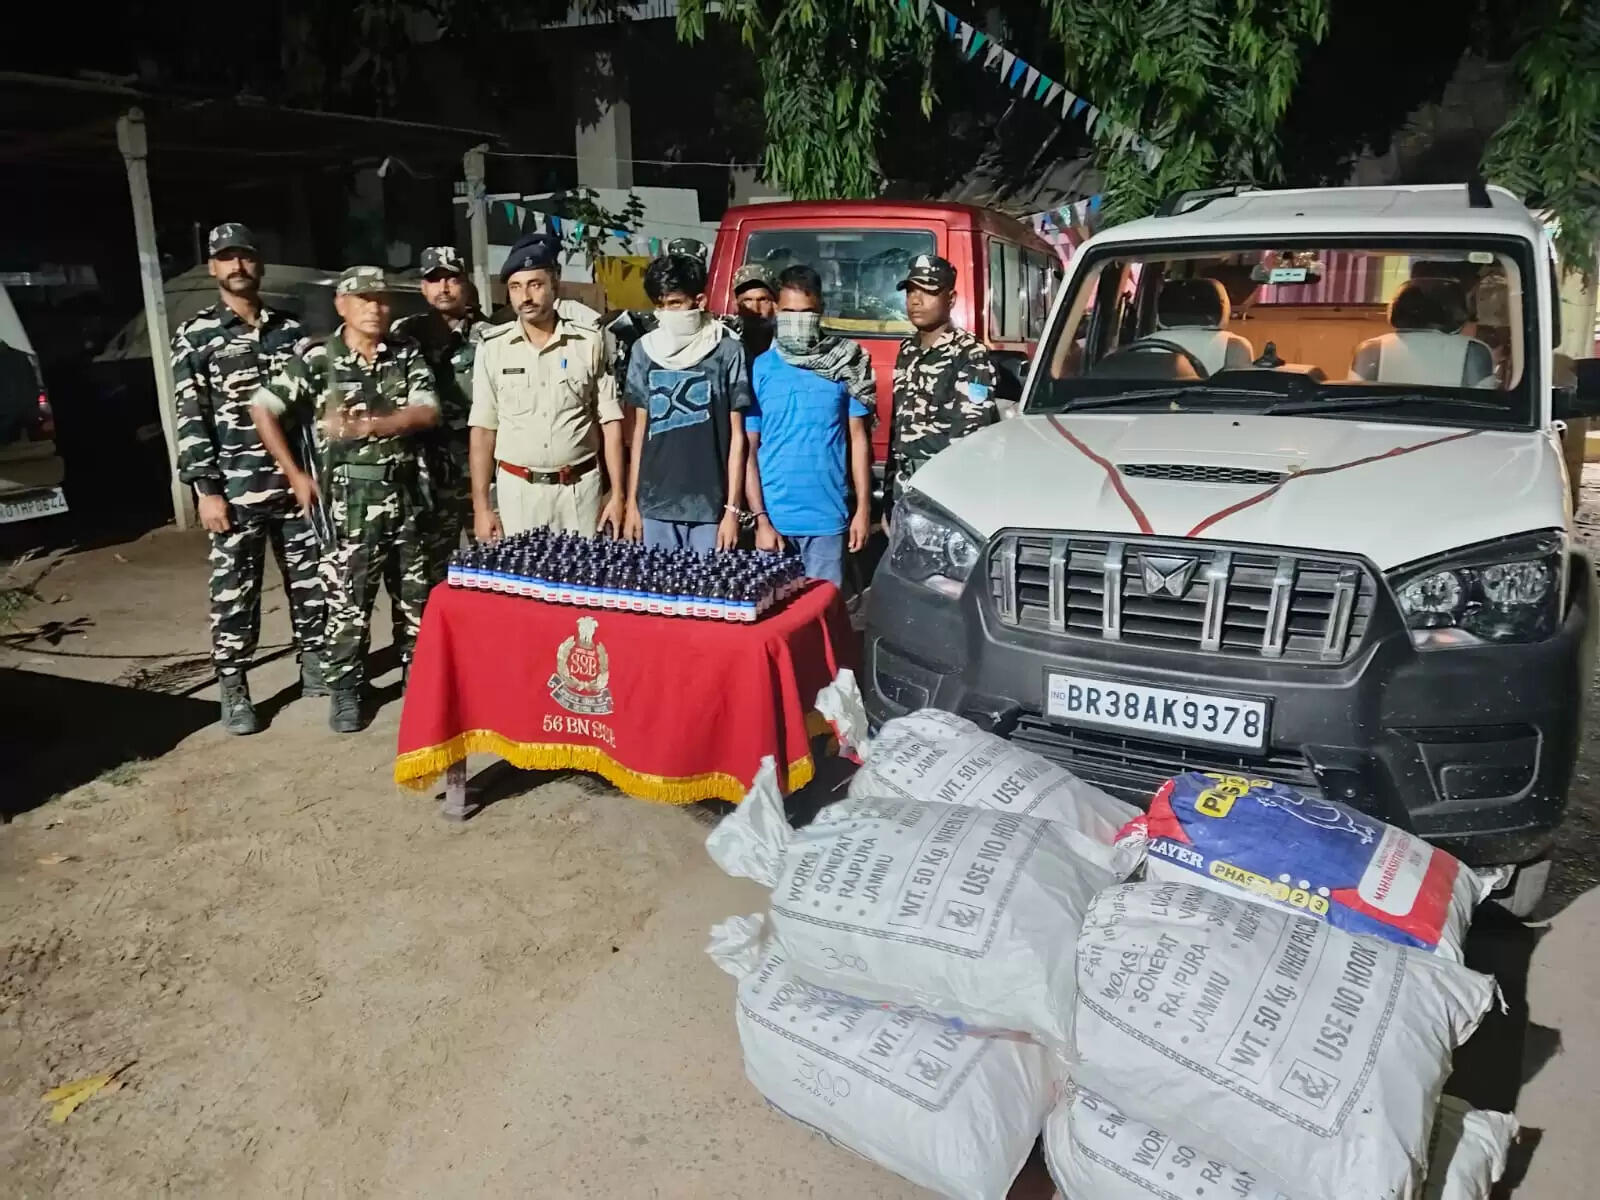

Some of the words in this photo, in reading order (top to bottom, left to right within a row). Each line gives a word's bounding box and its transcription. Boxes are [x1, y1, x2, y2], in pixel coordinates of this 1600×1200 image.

[570, 653, 597, 676] SSB
[543, 714, 563, 732] 56
[566, 716, 590, 736] BN
[1067, 684, 1260, 738] BR38AK9378
[936, 776, 966, 801] WT.
[959, 763, 977, 781] 50
[992, 774, 1026, 805] USE
[937, 822, 961, 851] WHEN
[814, 834, 853, 894] SONEPAT
[838, 837, 879, 898] RAJPURA
[862, 854, 894, 903] JAMMU
[912, 867, 935, 887] 50
[960, 862, 996, 896] USE
[978, 838, 1007, 863] NO
[900, 889, 928, 918] WT.
[1295, 890, 1304, 903] 2
[1314, 900, 1324, 911] 3
[1133, 933, 1180, 1003] SONEPAT
[1275, 943, 1308, 981] WHEN
[1187, 971, 1231, 1033] JAMMU
[1264, 984, 1298, 1009] Kg.
[1331, 986, 1365, 1019] NO
[1253, 1005, 1282, 1032] 50
[870, 1028, 903, 1058] WT.
[933, 1026, 965, 1052] US
[1230, 1030, 1271, 1067] WT.
[1312, 1013, 1354, 1062] USE
[1132, 1130, 1168, 1167] WOR
